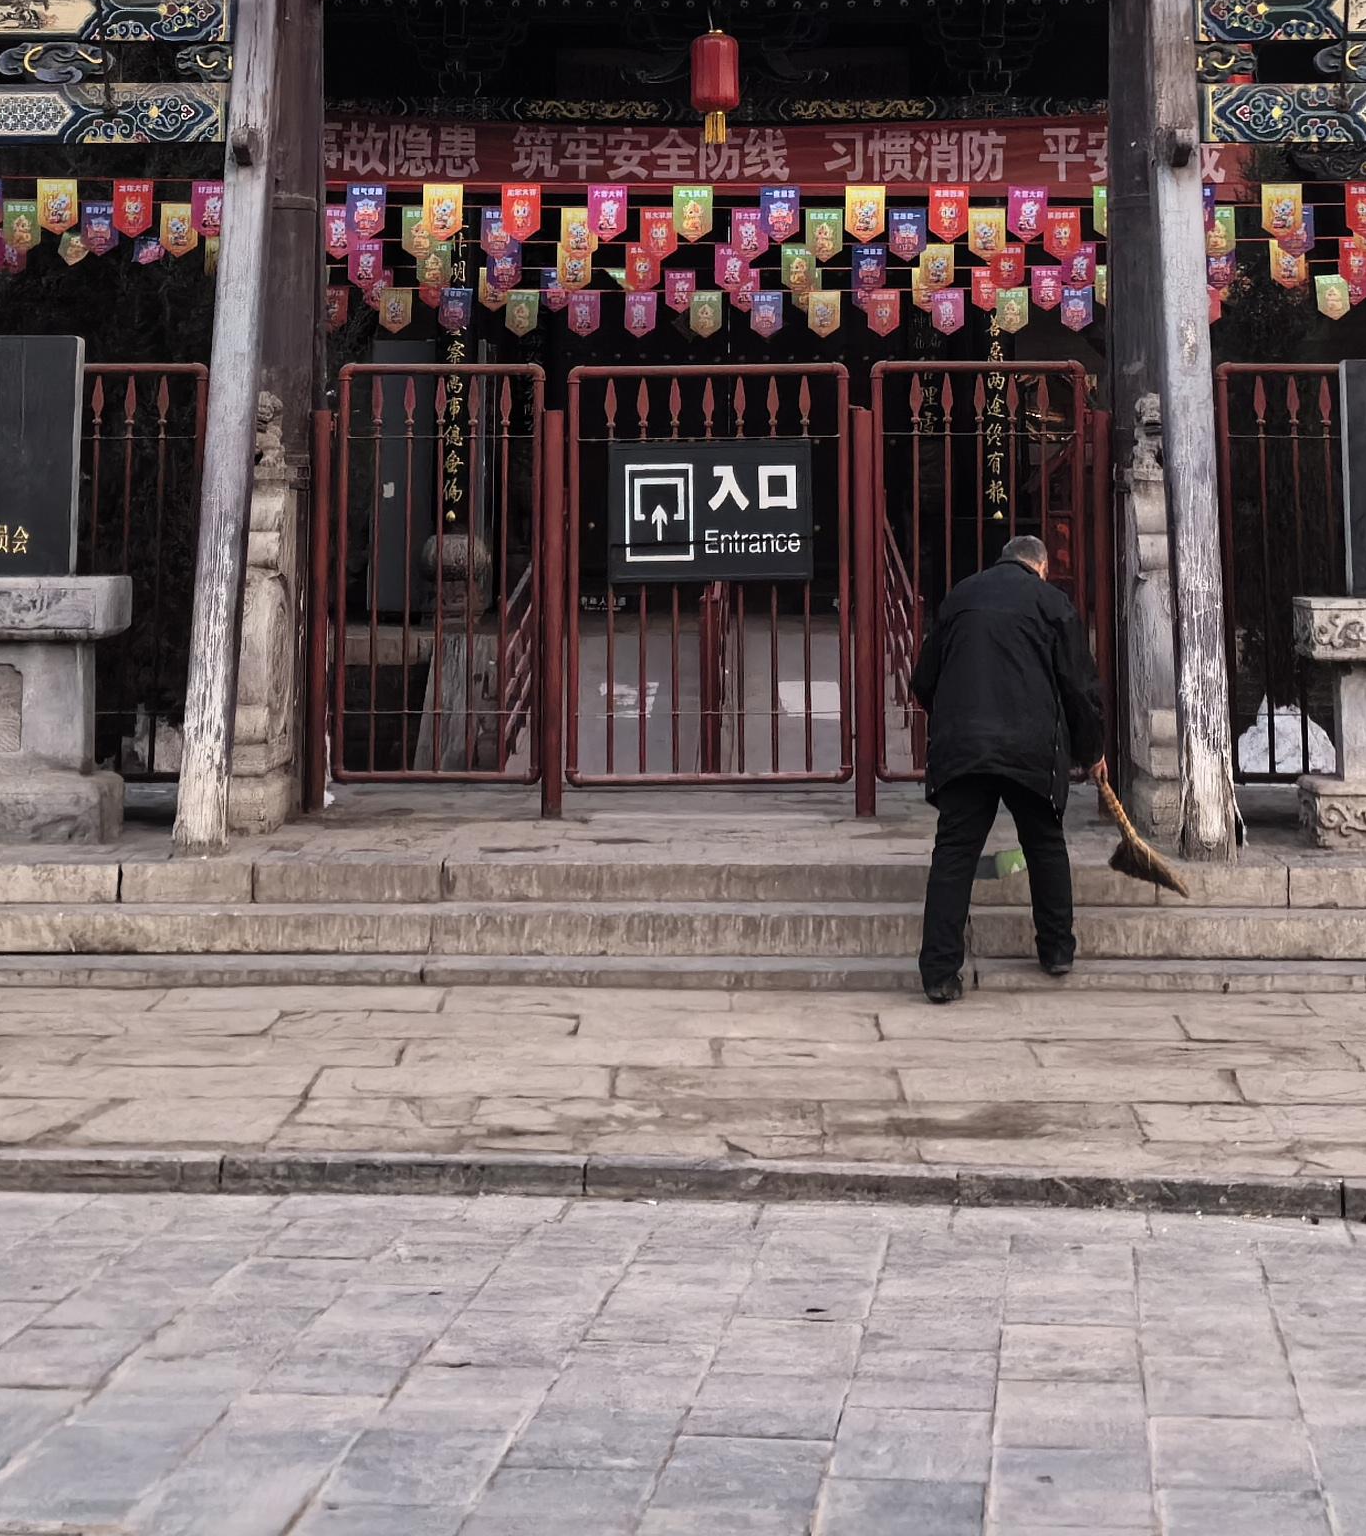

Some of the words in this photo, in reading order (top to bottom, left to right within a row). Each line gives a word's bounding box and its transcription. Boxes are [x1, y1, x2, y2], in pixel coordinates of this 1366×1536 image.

[511, 126, 790, 182] 筑牢安全防线
[824, 129, 1006, 182] 习惯消防
[707, 465, 798, 511] 入口
[704, 529, 801, 554] Entrance
